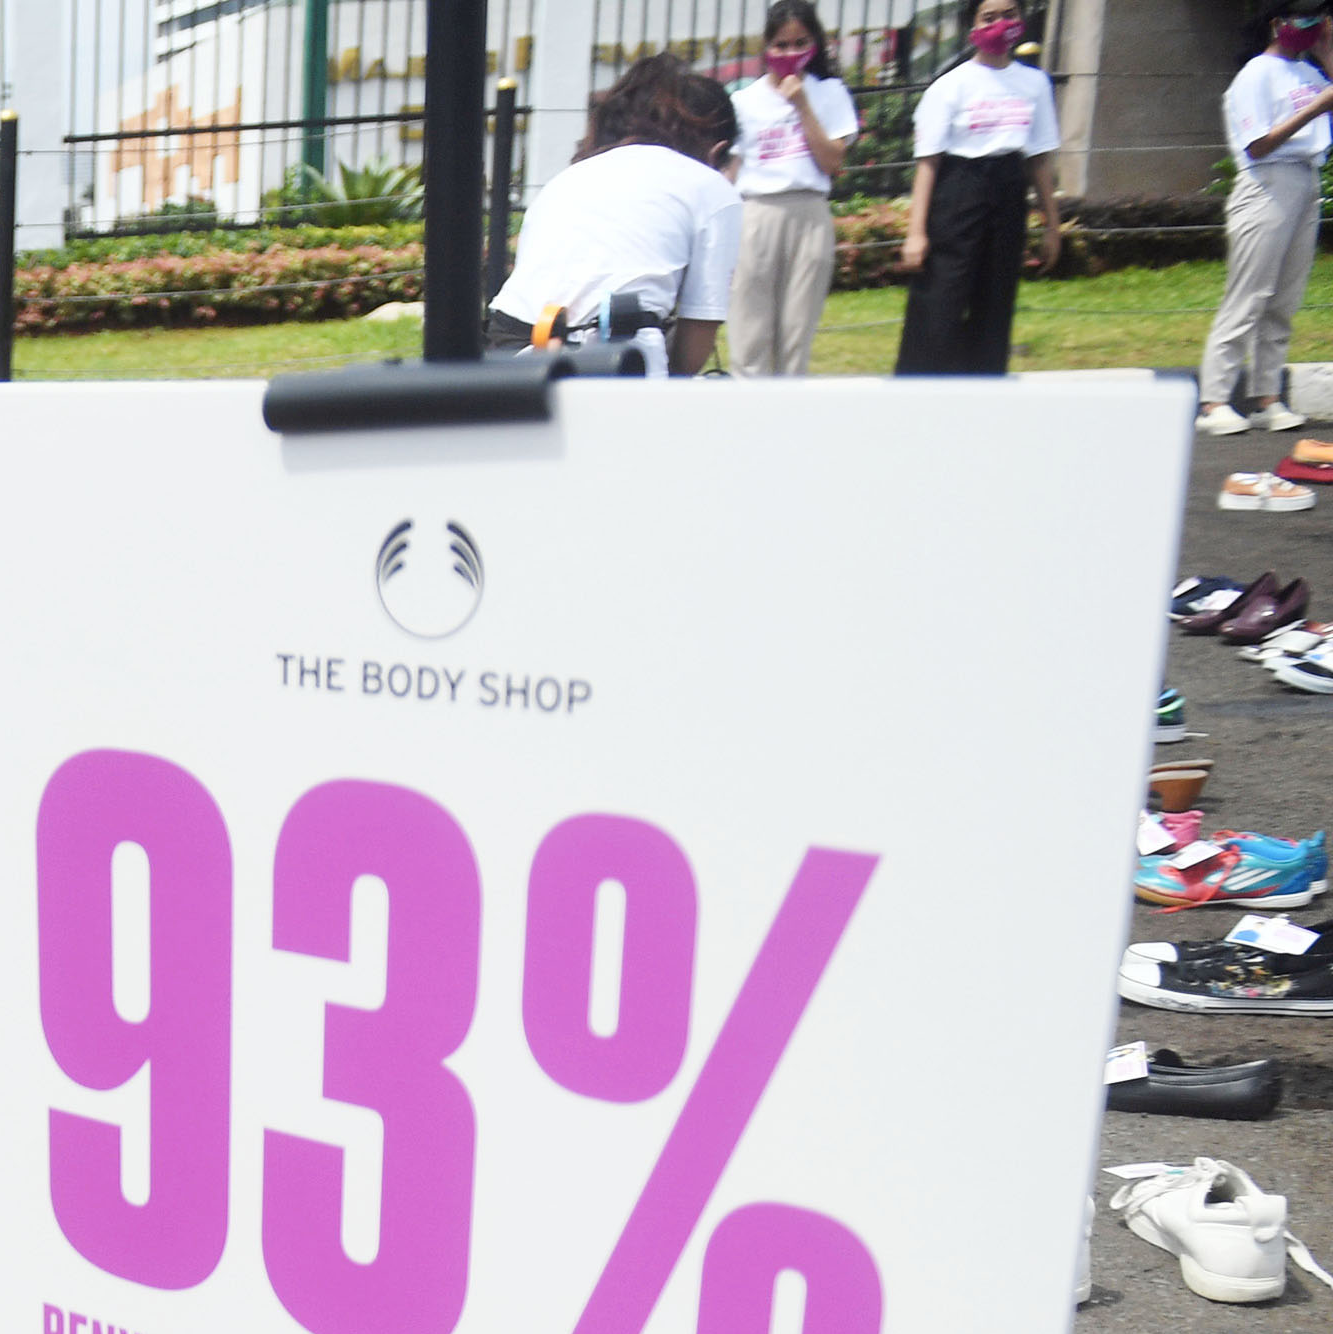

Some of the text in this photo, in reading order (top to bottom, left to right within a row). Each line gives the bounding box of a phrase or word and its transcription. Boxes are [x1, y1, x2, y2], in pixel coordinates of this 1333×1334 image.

[276, 653, 593, 713] THE BODY SHOP
